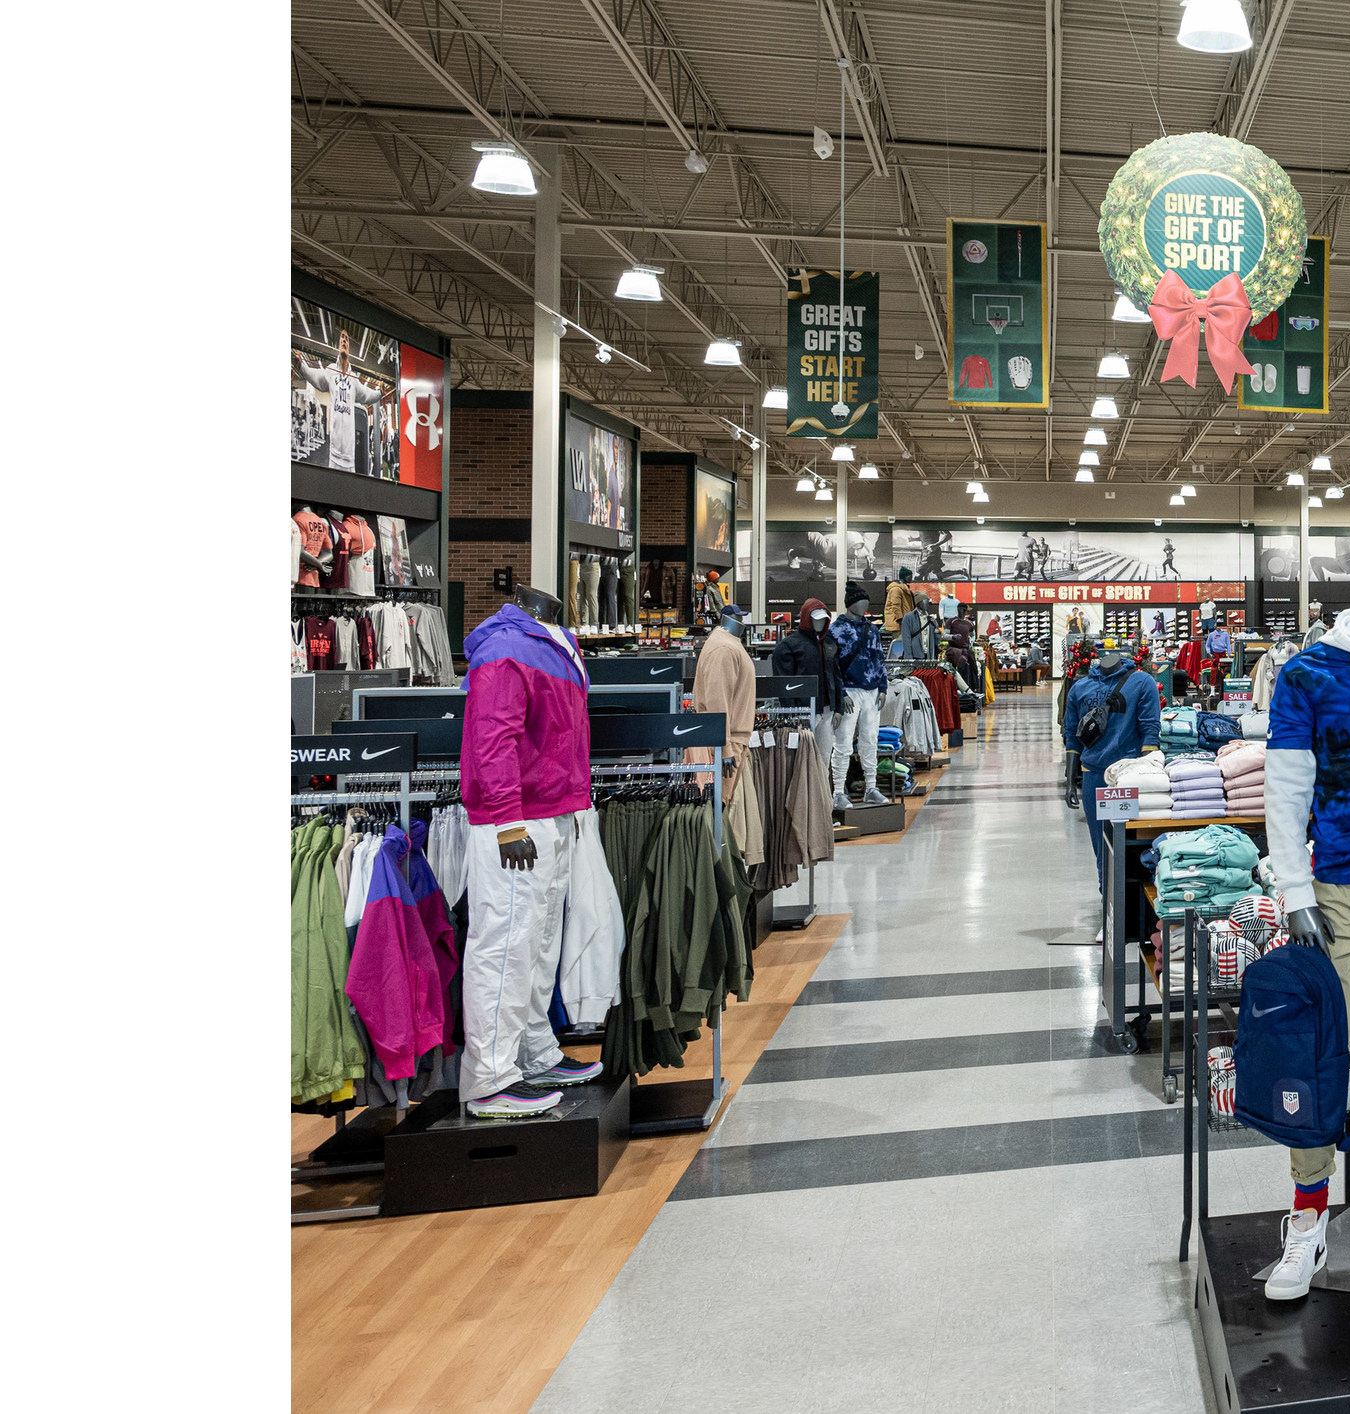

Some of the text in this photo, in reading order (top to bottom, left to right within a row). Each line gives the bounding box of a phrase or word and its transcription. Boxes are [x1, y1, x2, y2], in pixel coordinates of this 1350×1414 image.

[1165, 192, 1245, 218] GIVE THE
[1164, 215, 1245, 243] GIFT OF
[1164, 241, 1245, 272] SPORT
[801, 304, 866, 327] GREAT
[804, 329, 862, 352] GIFTS
[800, 355, 866, 378] START
[807, 380, 859, 403] HERE
[1003, 585, 1152, 601] GIVE THE GIFT OF SPORT
[1228, 693, 1248, 701] SALE
[291, 748, 351, 763] SWEAR
[1103, 788, 1132, 799] SALE
[1283, 1092, 1298, 1102] USA
